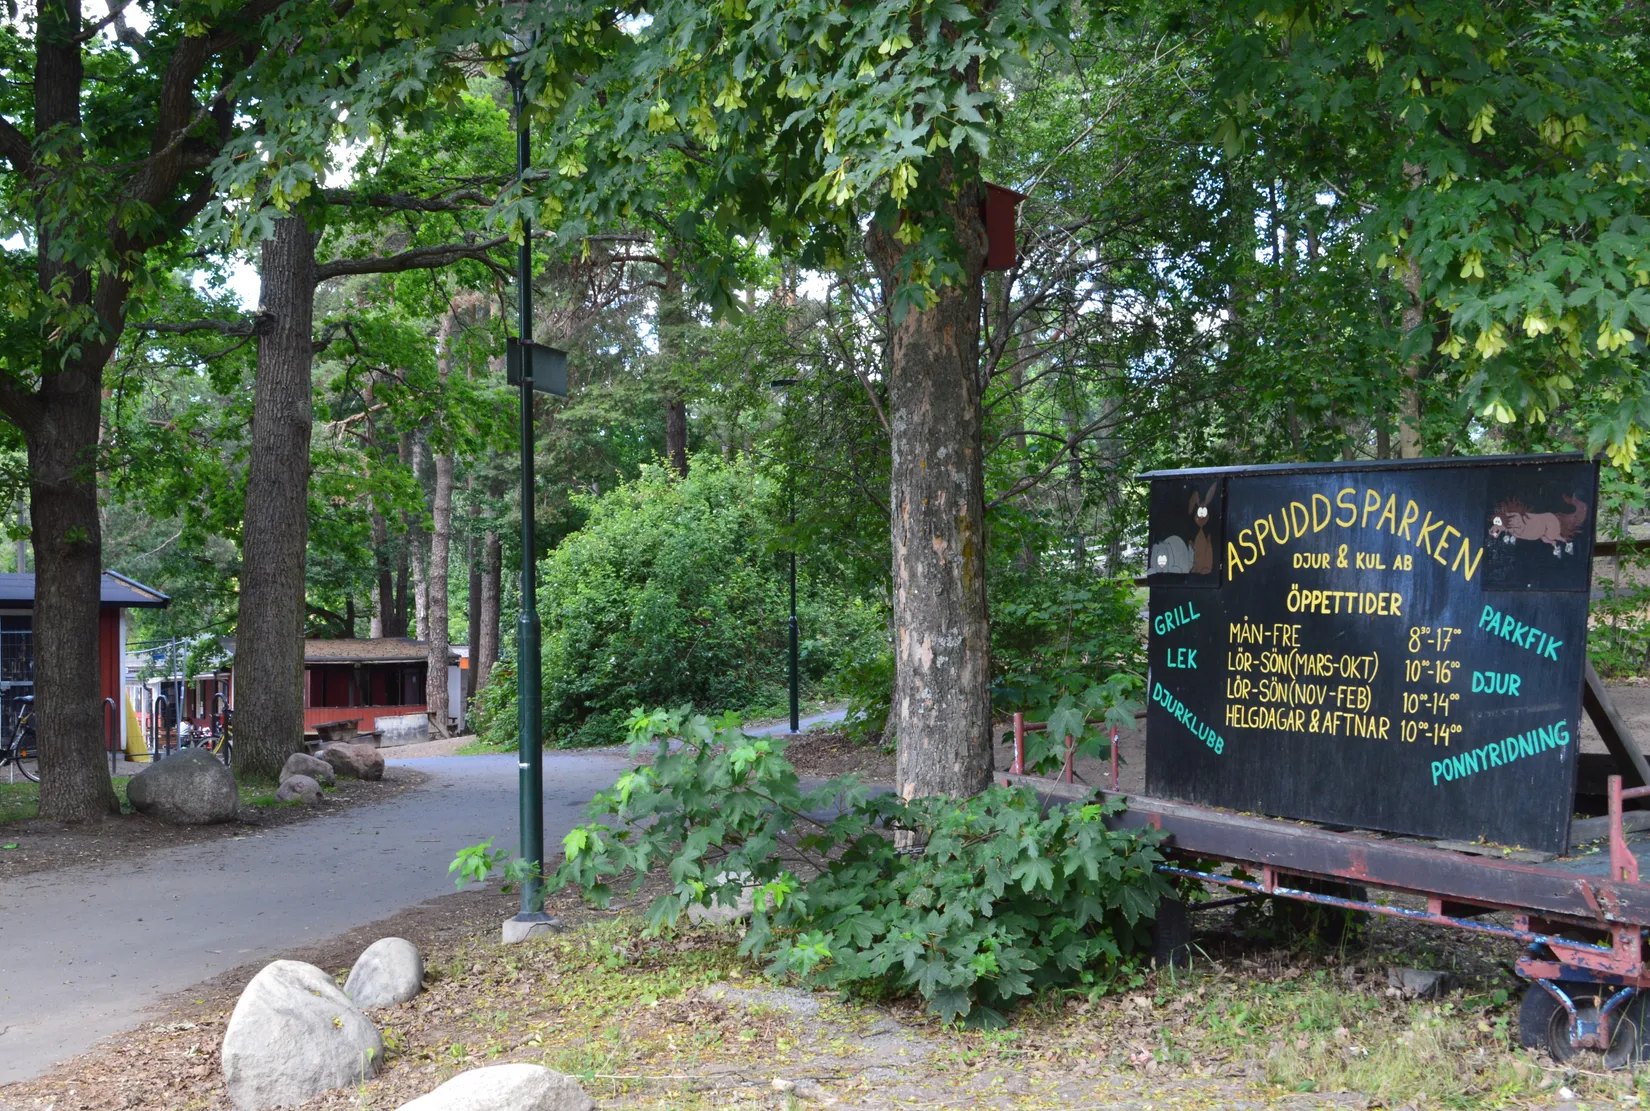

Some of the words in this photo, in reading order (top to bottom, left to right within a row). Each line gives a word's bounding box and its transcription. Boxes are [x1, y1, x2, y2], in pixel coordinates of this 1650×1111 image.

[1227, 487, 1484, 581] ASPUDDSPARKEN
[1293, 553, 1331, 569] DJUR
[1336, 544, 1349, 569] &
[1356, 553, 1385, 569] KUL
[1393, 555, 1413, 570] AB
[1286, 583, 1402, 616] ÖPPETTIDER
[1154, 601, 1201, 636] GRILL
[1229, 615, 1302, 647] MÅN-FRE
[1478, 604, 1563, 662] PARKFIK
[1167, 647, 1198, 670] LEK
[1471, 670, 1522, 697] DJUR
[1152, 681, 1225, 754] DJURKLUBB
[1225, 704, 1305, 733] HELGDAGAR
[1321, 711, 1391, 740] AFTNAR
[1431, 720, 1571, 787] PONNYRIDNING
